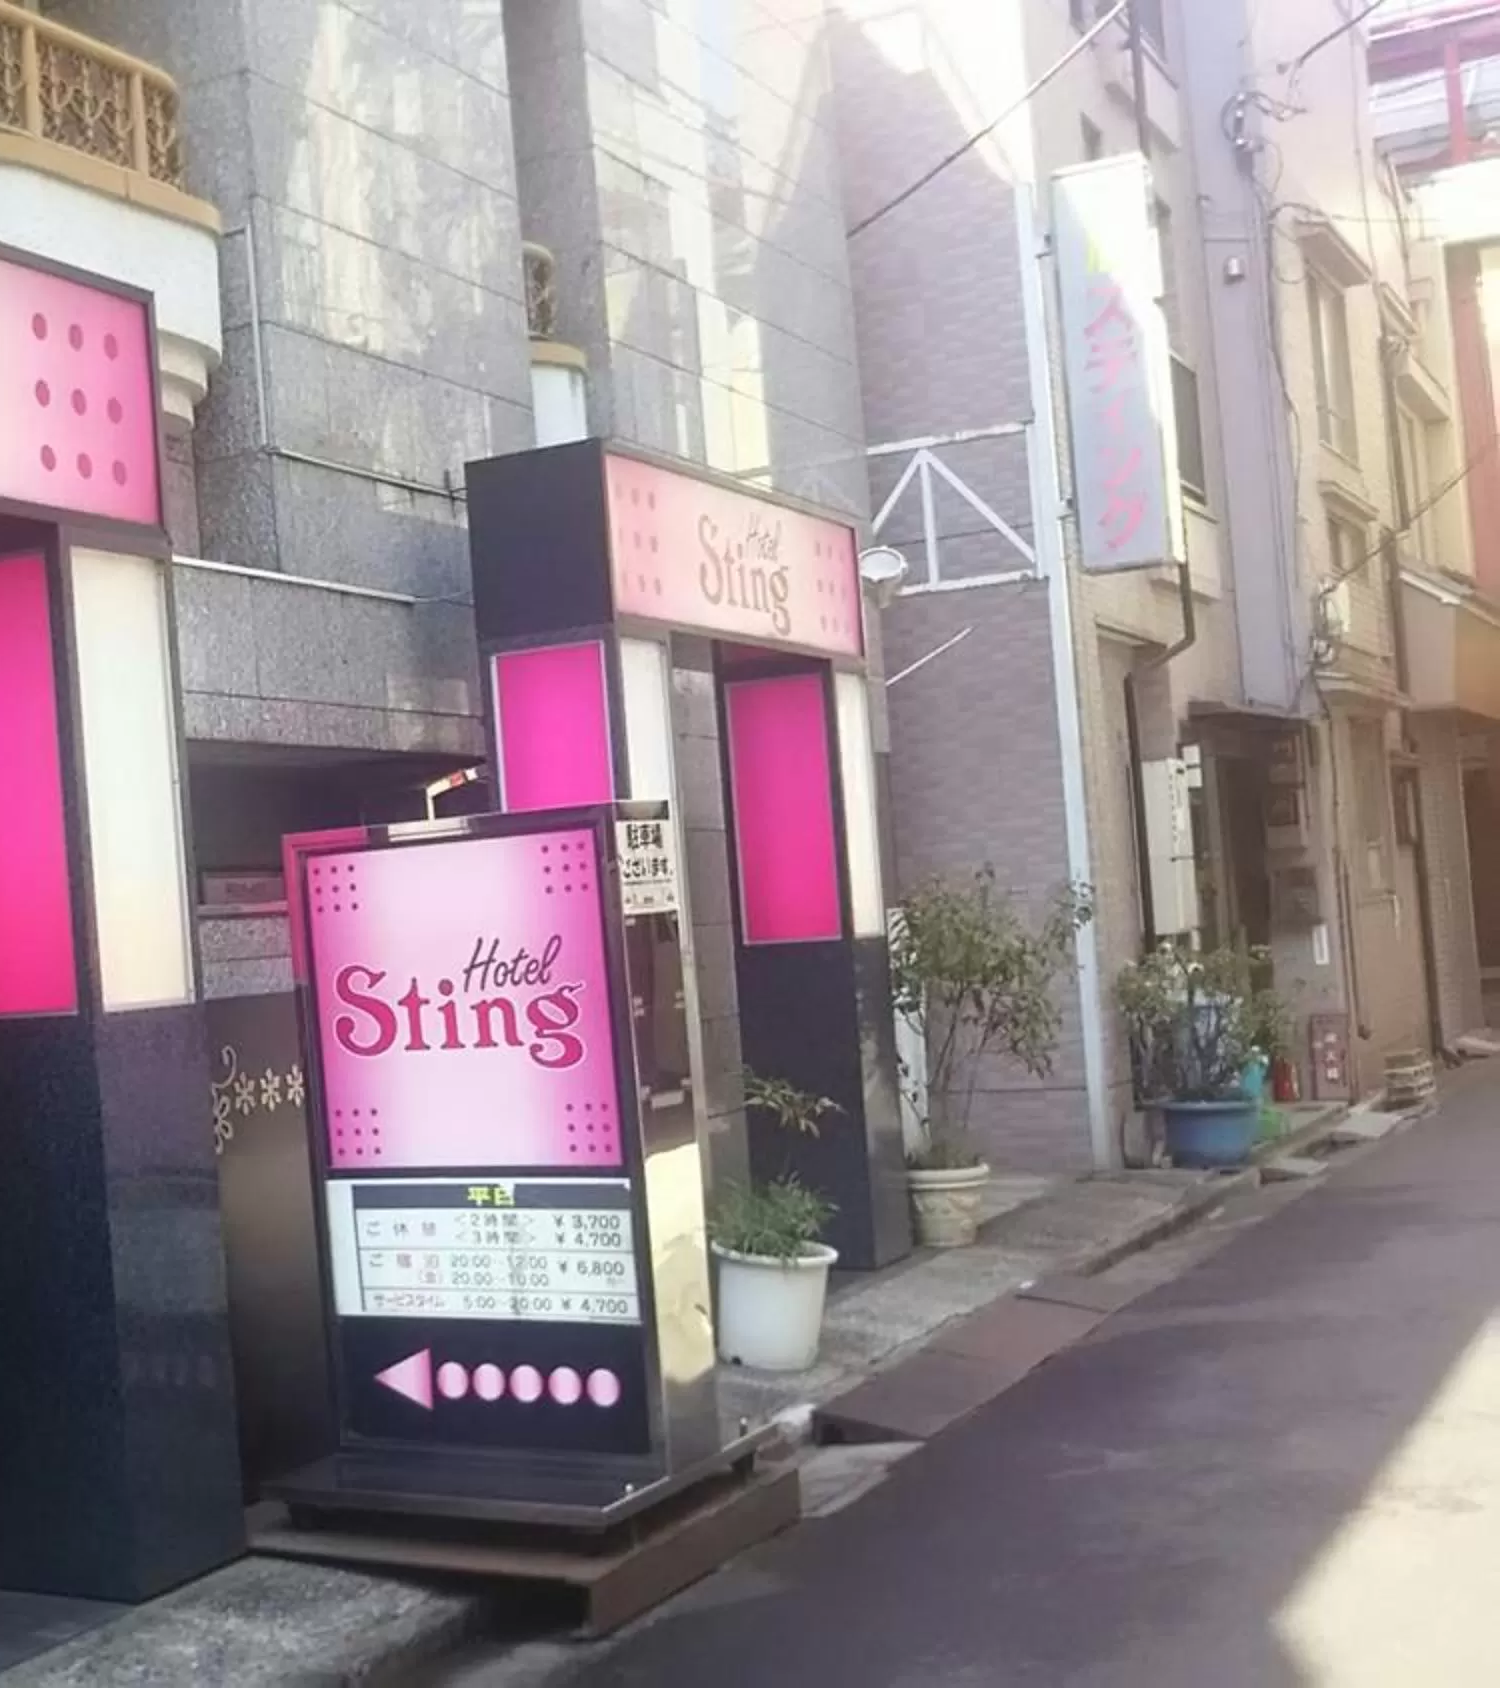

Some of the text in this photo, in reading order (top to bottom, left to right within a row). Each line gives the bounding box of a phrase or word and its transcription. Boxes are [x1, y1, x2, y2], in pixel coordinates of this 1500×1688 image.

[698, 513, 791, 636] Sting
[463, 934, 562, 993] Hotel
[335, 965, 583, 1069] Sting
